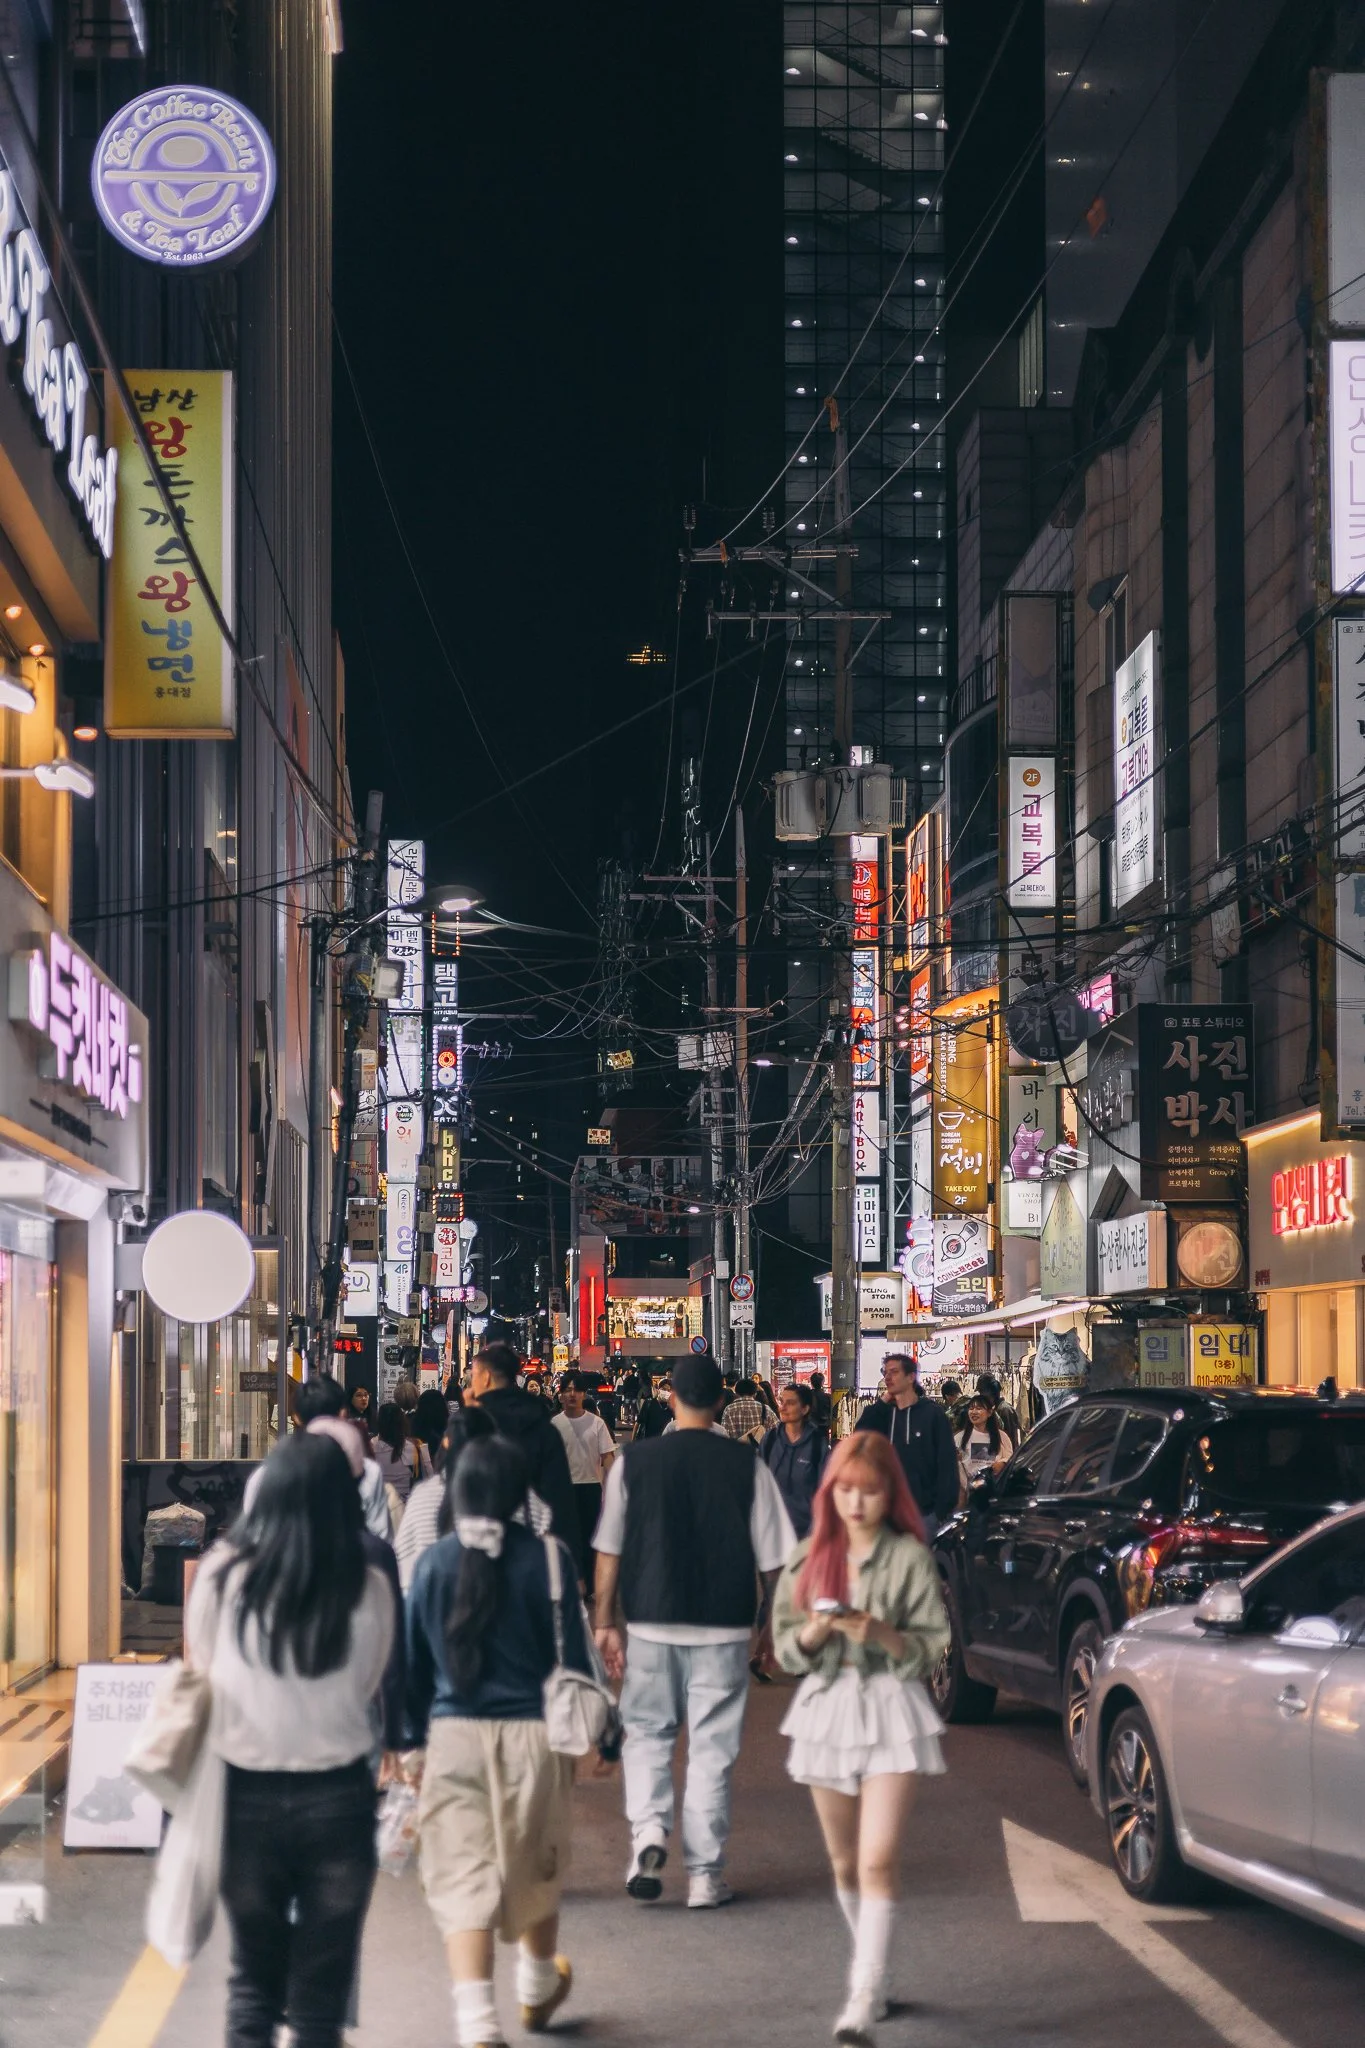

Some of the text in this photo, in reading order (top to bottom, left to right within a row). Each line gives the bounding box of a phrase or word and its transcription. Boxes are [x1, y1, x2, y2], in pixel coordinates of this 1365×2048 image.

[104, 93, 258, 170] The Coffee Bean
[120, 203, 243, 252] & Tea Leaf
[163, 251, 204, 262] Est. 1963
[134, 388, 198, 412] 남산
[154, 687, 191, 698] 홍대점
[1026, 773, 1038, 782] 2F
[1121, 740, 1149, 799] 교복대여
[1021, 794, 1043, 876] 교복몰
[1019, 884, 1046, 893] 교복대여
[1181, 1017, 1245, 1028] 포토 스튜디오
[1040, 1047, 1057, 1057] B1
[1162, 1035, 1249, 1082] 사진
[1163, 1091, 1254, 1138] 박사
[855, 1098, 867, 1171] ARTBOX
[442, 1129, 454, 1182] bhc
[940, 1147, 983, 1176] 설빙
[954, 1195, 968, 1205] 2F
[1271, 1156, 1352, 1236] 인생네컷
[863, 1188, 876, 1248] 리마이너스
[397, 1225, 413, 1255] CU
[1099, 1222, 1148, 1274] 수상한사진관
[439, 1247, 454, 1278] 코인
[955, 1277, 988, 1293] 코인
[1203, 1275, 1219, 1284] B1
[1144, 1335, 1185, 1361] 임
[1198, 1333, 1250, 1357] 임대
[1213, 1359, 1236, 1369] (3층)
[86, 1702, 148, 1723] 넘나싫
